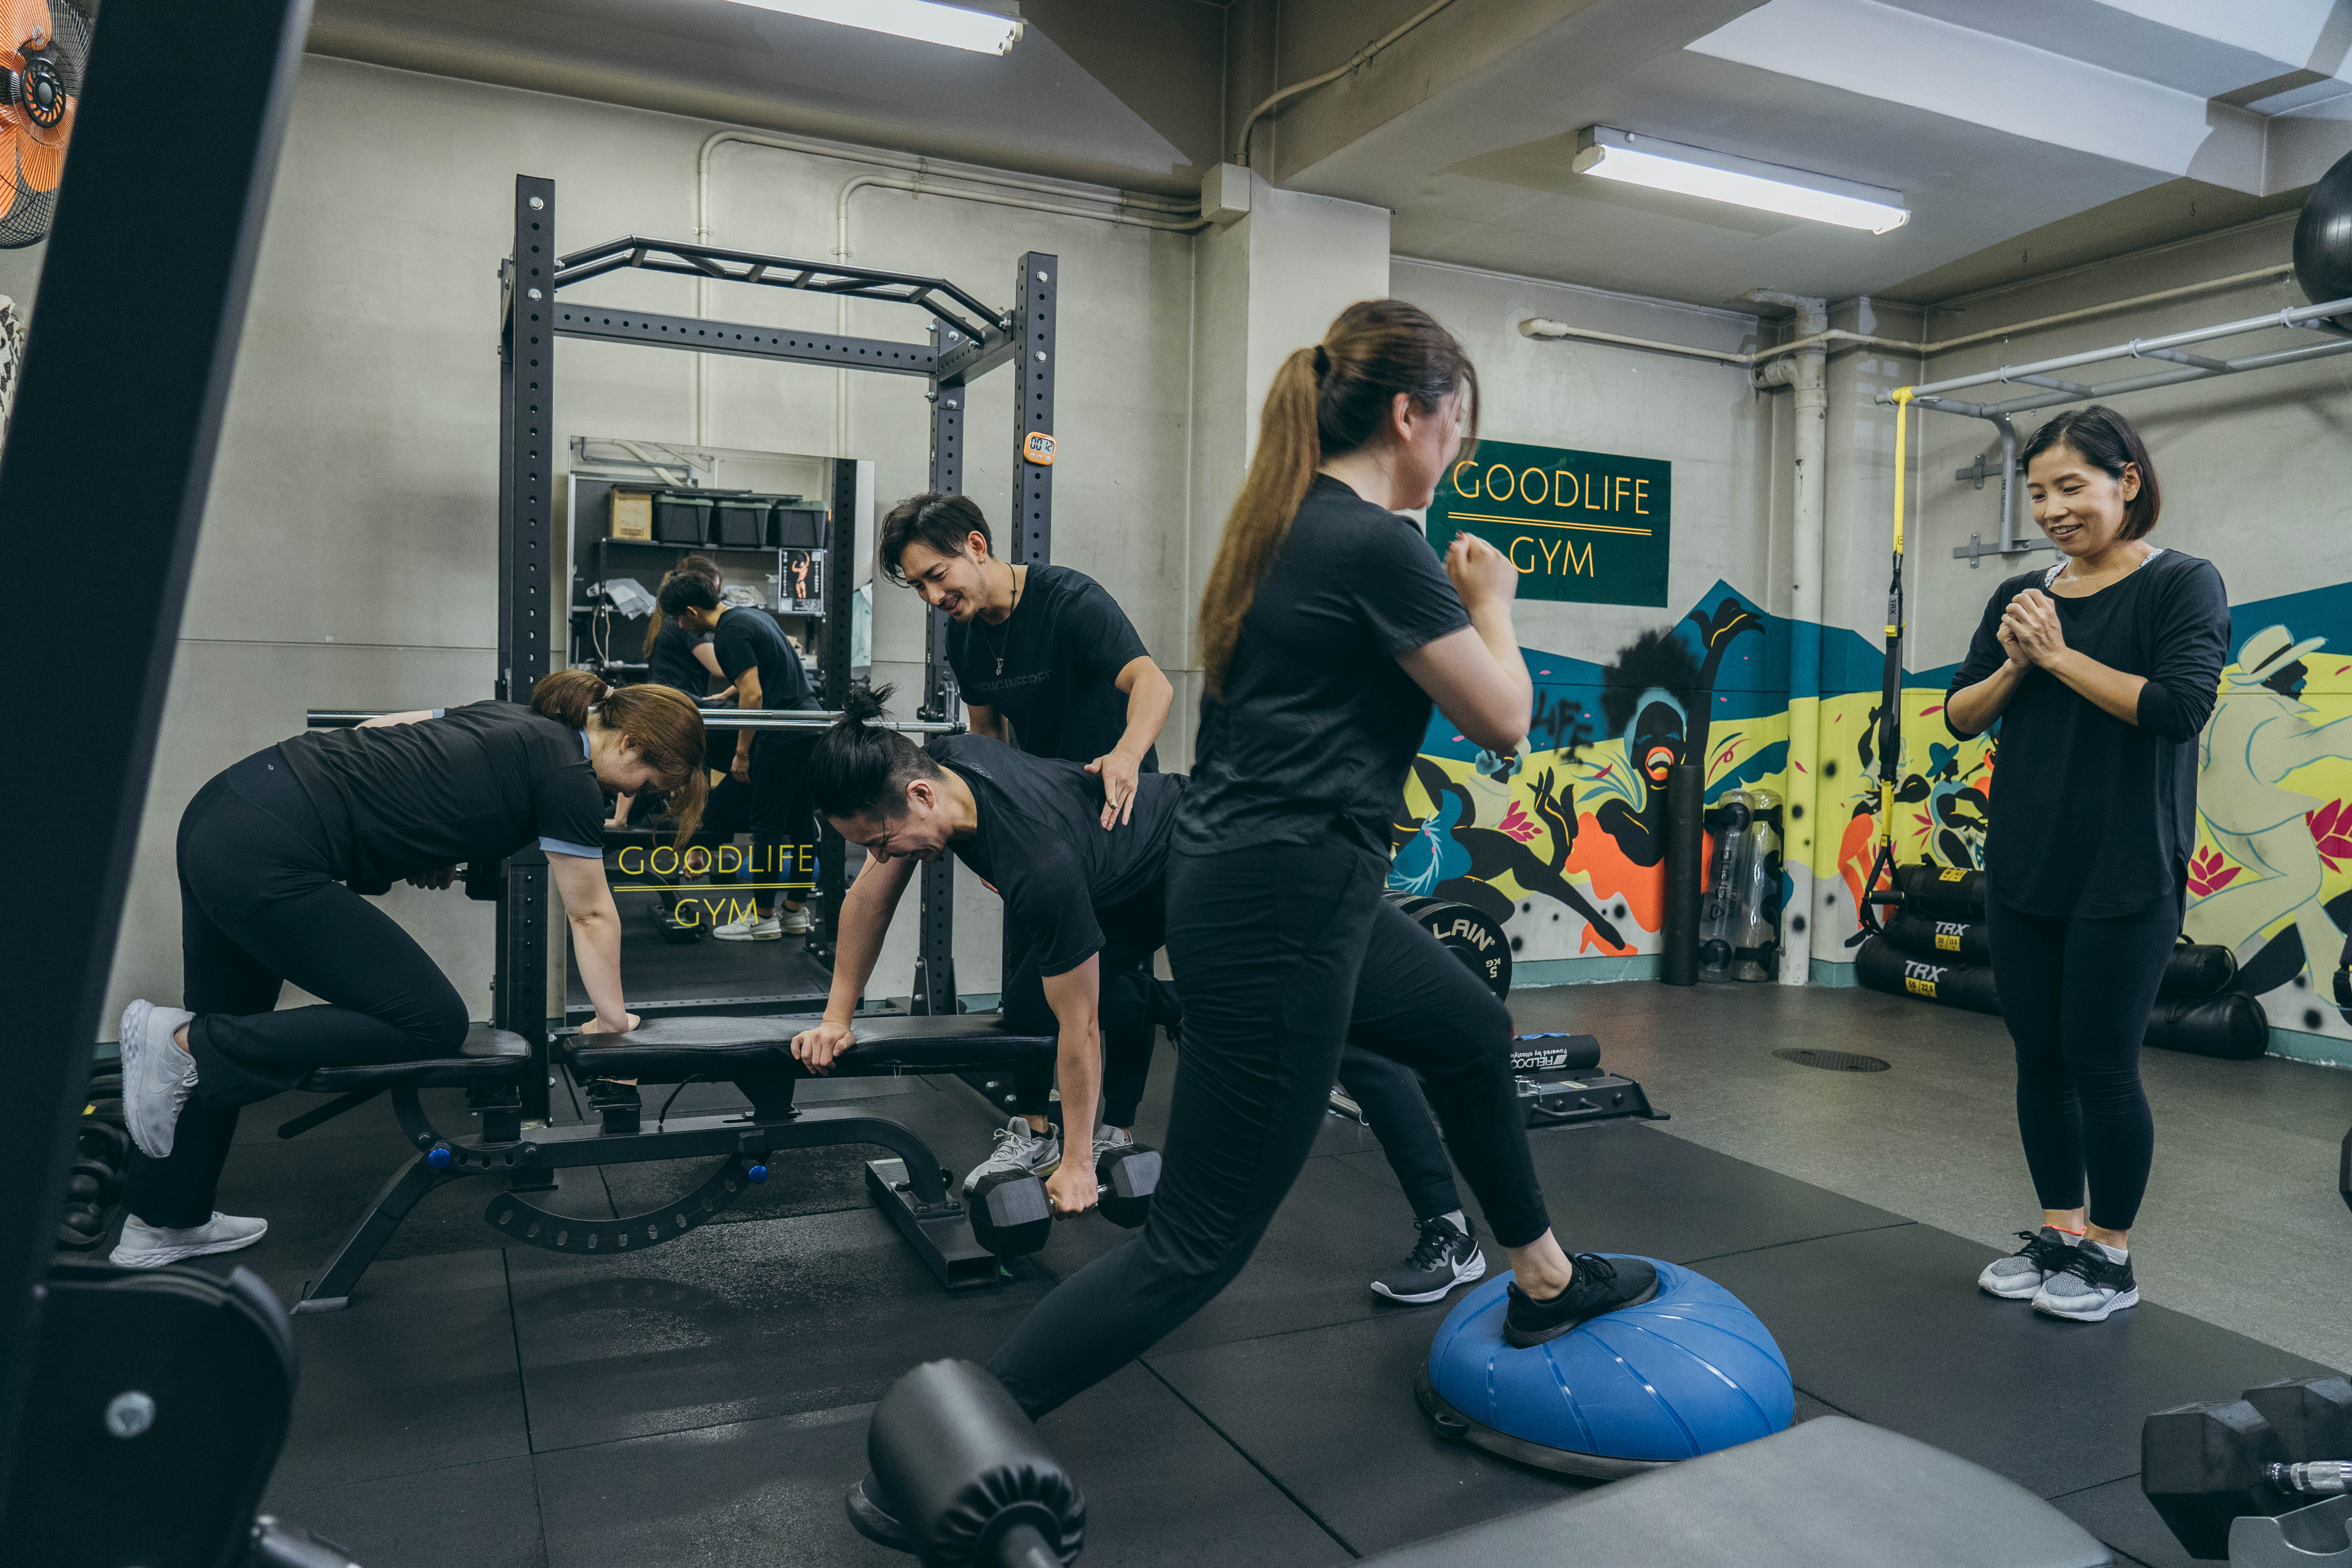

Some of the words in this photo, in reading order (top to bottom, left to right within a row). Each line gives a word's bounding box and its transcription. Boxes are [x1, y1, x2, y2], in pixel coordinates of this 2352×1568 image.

[1453, 460, 1649, 514] GOODLIFE
[1510, 536, 1593, 577] GYM
[619, 844, 813, 875] GOODLIFE
[675, 897, 759, 927] GYM
[1935, 921, 1970, 936] TRX
[1486, 958, 1501, 967] KG
[1905, 960, 1948, 982] TRX
[1490, 966, 1497, 978] 5
[1535, 1050, 1542, 1058] by
[1543, 1048, 1567, 1057] Powered
